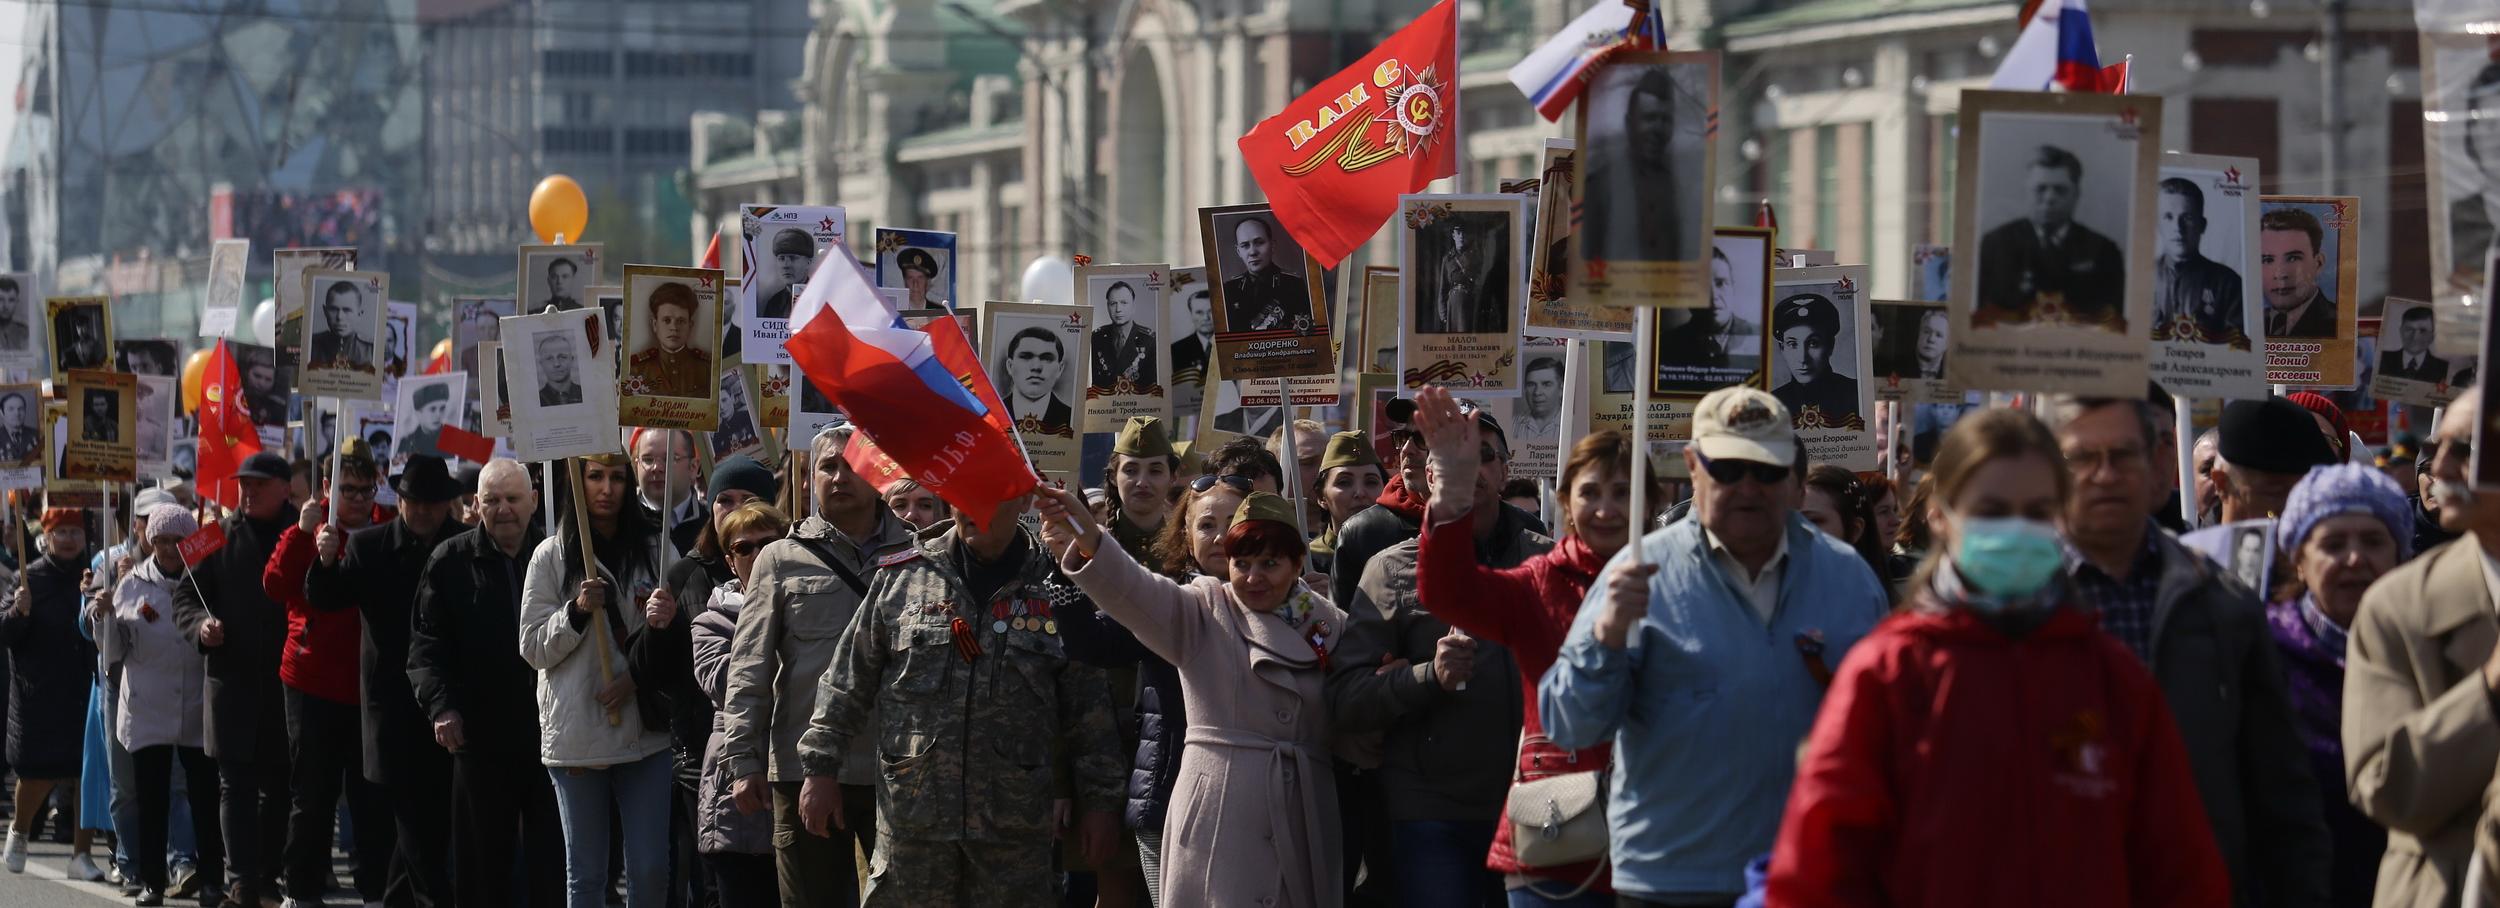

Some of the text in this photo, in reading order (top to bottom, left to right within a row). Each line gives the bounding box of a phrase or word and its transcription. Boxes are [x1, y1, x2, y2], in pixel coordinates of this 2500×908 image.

[753, 330, 777, 339] Иван
[1248, 339, 1299, 350] ХОДОРЕНКО
[1423, 344, 1501, 352] Николай Васильевич
[1234, 348, 1316, 360] Владимир Кондратьевич
[2165, 346, 2206, 360] Токарев
[2265, 354, 2309, 366] Леонид
[2171, 362, 2252, 377] Александрович
[2267, 371, 2320, 380] ексеевич
[1250, 377, 1335, 386] Никола Михайлович
[2161, 375, 2212, 386] старшина
[1290, 396, 1321, 404] 4.04.1994
[1120, 407, 1161, 415] Трофимович
[1595, 412, 1628, 421] Эдуард
[1823, 434, 1858, 443] Егорович
[1841, 445, 1870, 453] дивизии
[1529, 451, 1556, 460] Ларин
